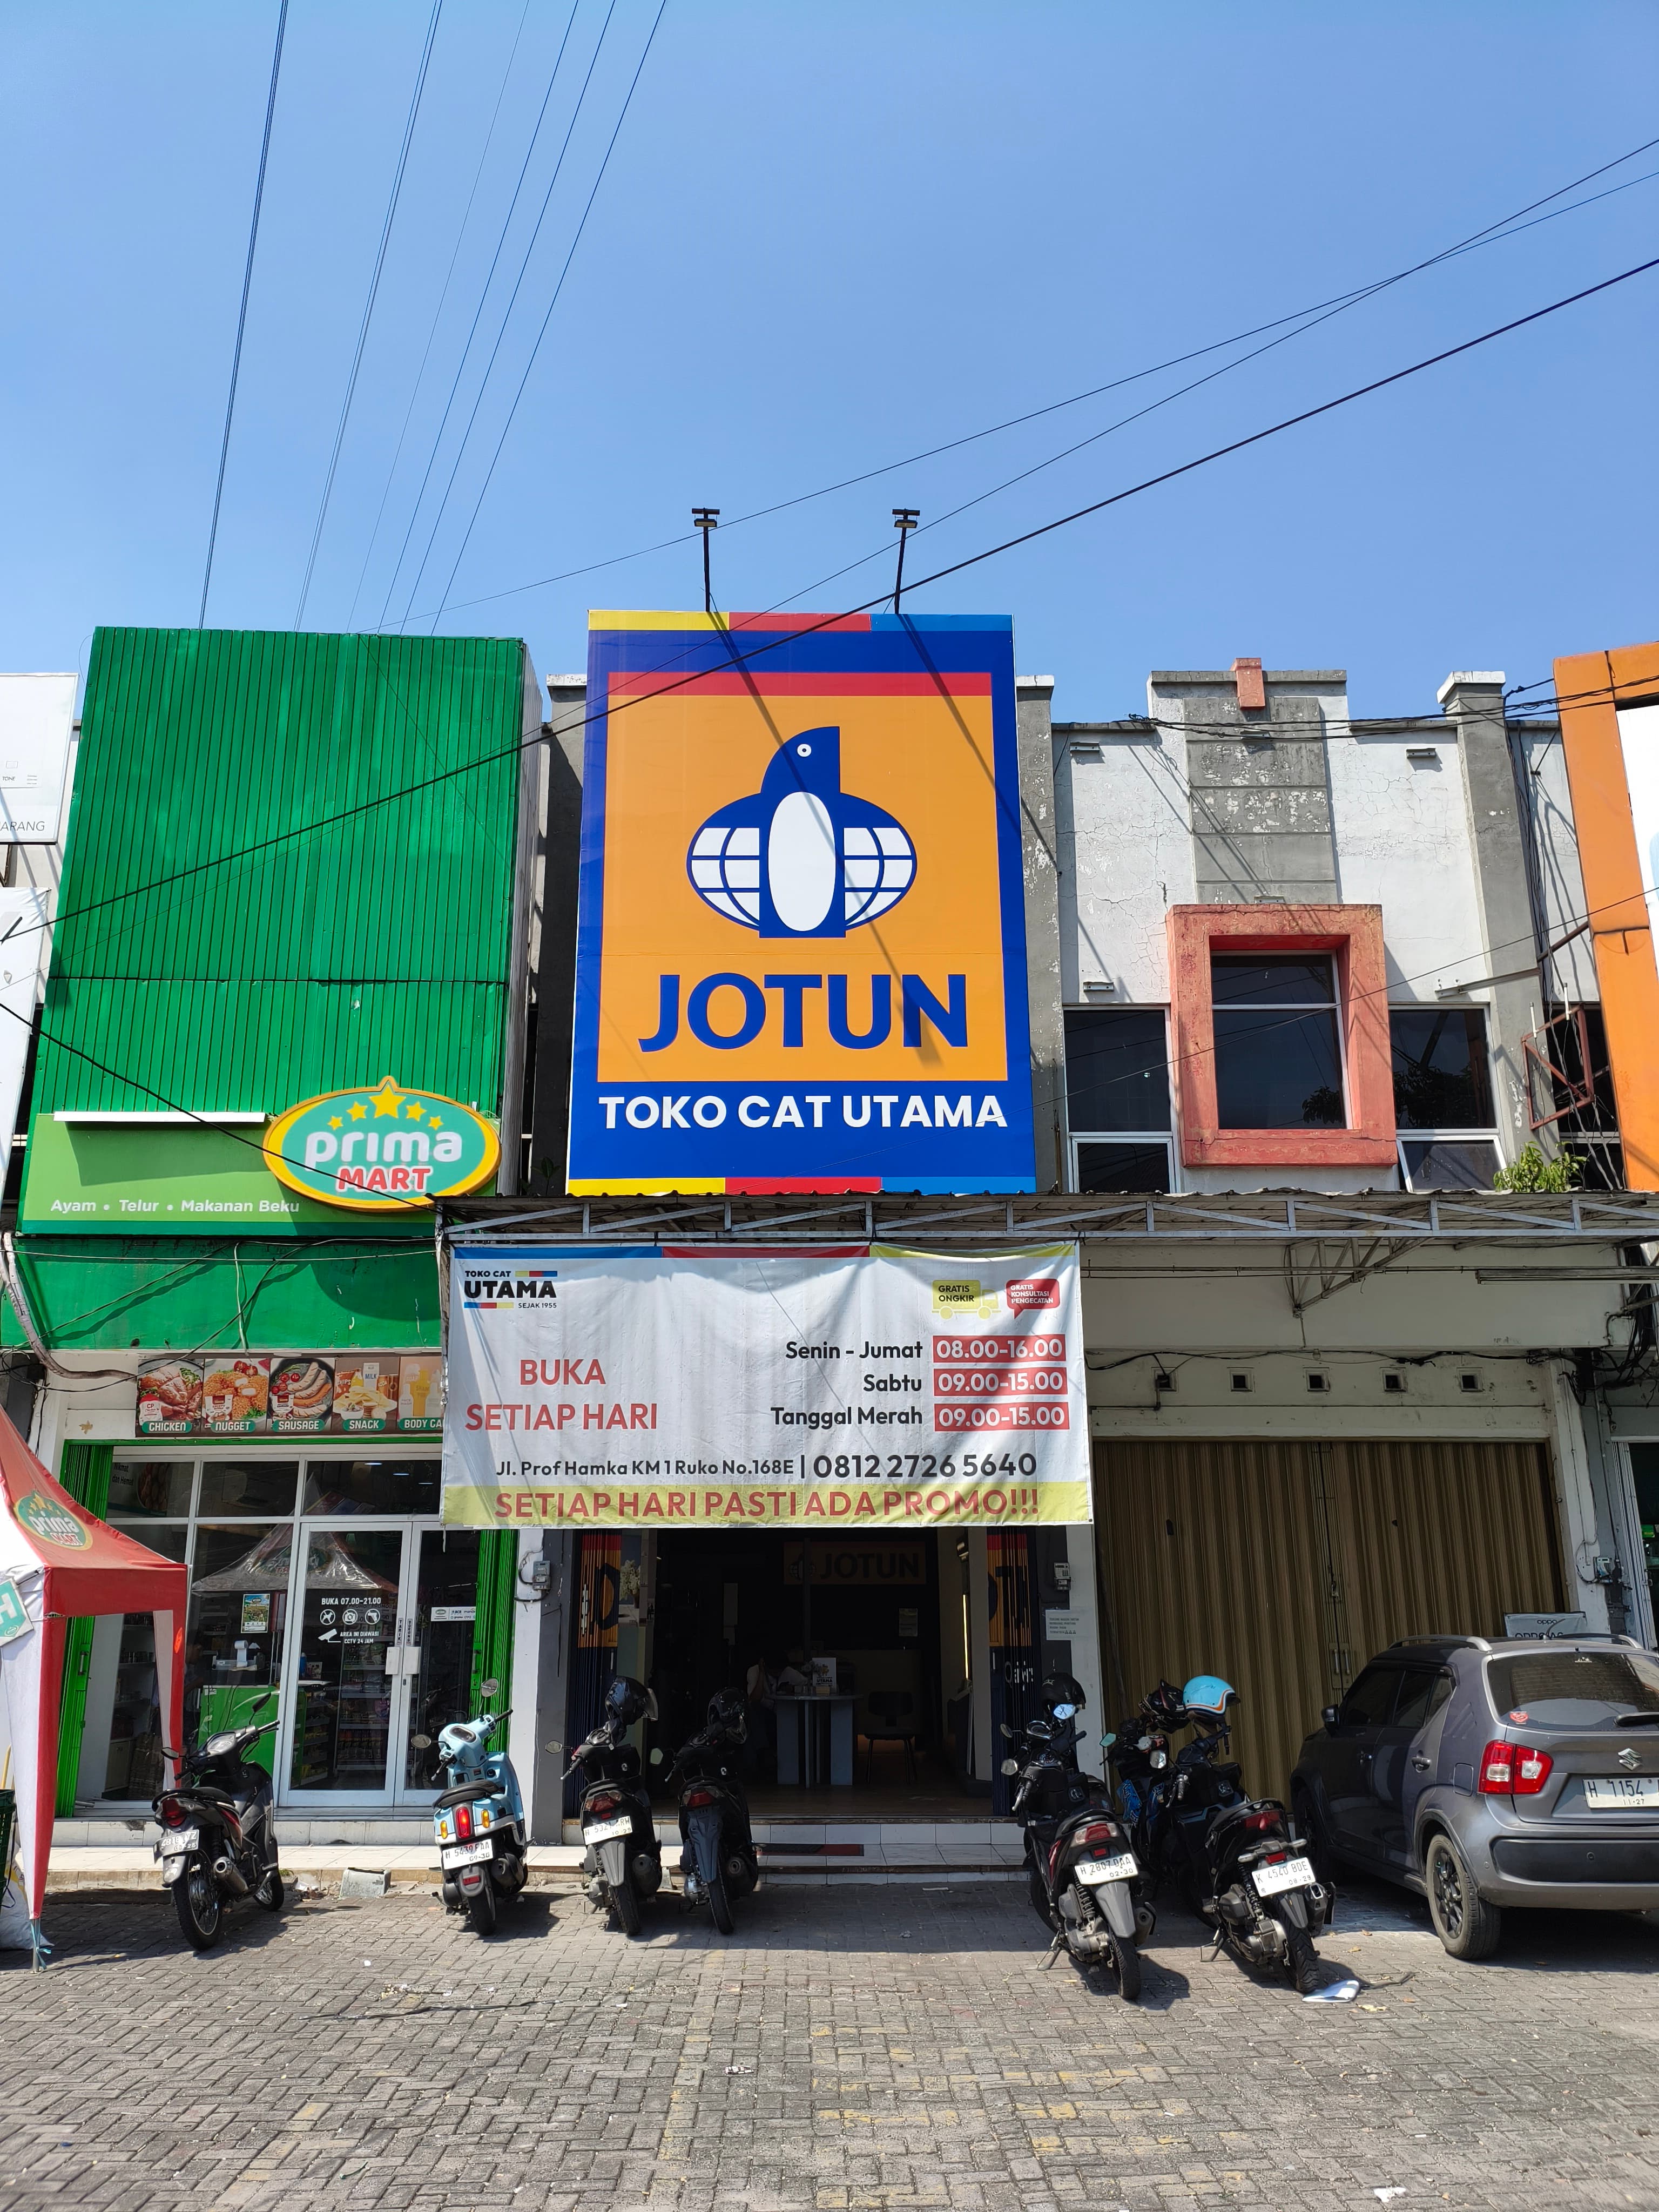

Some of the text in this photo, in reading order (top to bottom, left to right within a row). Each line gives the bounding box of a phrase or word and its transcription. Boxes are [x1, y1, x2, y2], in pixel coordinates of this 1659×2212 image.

[0, 821, 45, 831] ARANG
[638, 972, 969, 1053] JOTUN
[599, 1095, 1008, 1129] TOKO CAT UTAMA
[305, 1130, 463, 1171] prima
[336, 1165, 434, 1192] MART
[50, 1199, 300, 1215] Ayam Telur Makanan Beku
[464, 1280, 557, 1299] UTAMA
[786, 1341, 840, 1359] Senin
[859, 1341, 923, 1359] Jumat
[936, 1338, 1063, 1359] 08.00-16.00
[520, 1359, 606, 1385] BUKA
[938, 1371, 1063, 1392] 09.00-15.00
[864, 1373, 922, 1392] Sabtu
[149, 1422, 186, 1431] CHICKEN
[215, 1421, 251, 1431] NUGGET
[278, 1420, 319, 1430] SAUSAGE
[349, 1420, 379, 1429] SNACK
[404, 1419, 442, 1428] BODY CA
[465, 1403, 657, 1431] SETIAP HARI
[771, 1406, 923, 1430] Tanggal Merah
[939, 1406, 1065, 1427] 09.00-15.00
[496, 1461, 516, 1476] Jl.
[522, 1461, 562, 1475] Prof
[565, 1461, 628, 1475] Hamka
[632, 1460, 660, 1475] KM
[664, 1460, 670, 1474] 1
[676, 1460, 718, 1474] Ruko
[723, 1459, 794, 1474] No.168E
[813, 1454, 881, 1478] 0812
[887, 1454, 956, 1478] 2726
[962, 1453, 1037, 1476] 5640
[494, 1488, 1038, 1518] SETIAP HARI PASTI ADA PROMO!!!
[28, 1510, 79, 1535] prima
[50, 1533, 83, 1546] MART
[820, 1552, 919, 1580] JOTUN
[341, 1597, 381, 1605] 07.00-21.00
[1587, 1781, 1598, 1798] H
[1609, 1779, 1643, 1797] 1154
[445, 1851, 450, 1859] H
[1080, 1866, 1087, 1875] H
[1256, 1861, 1309, 1884] K 4540 BDE
